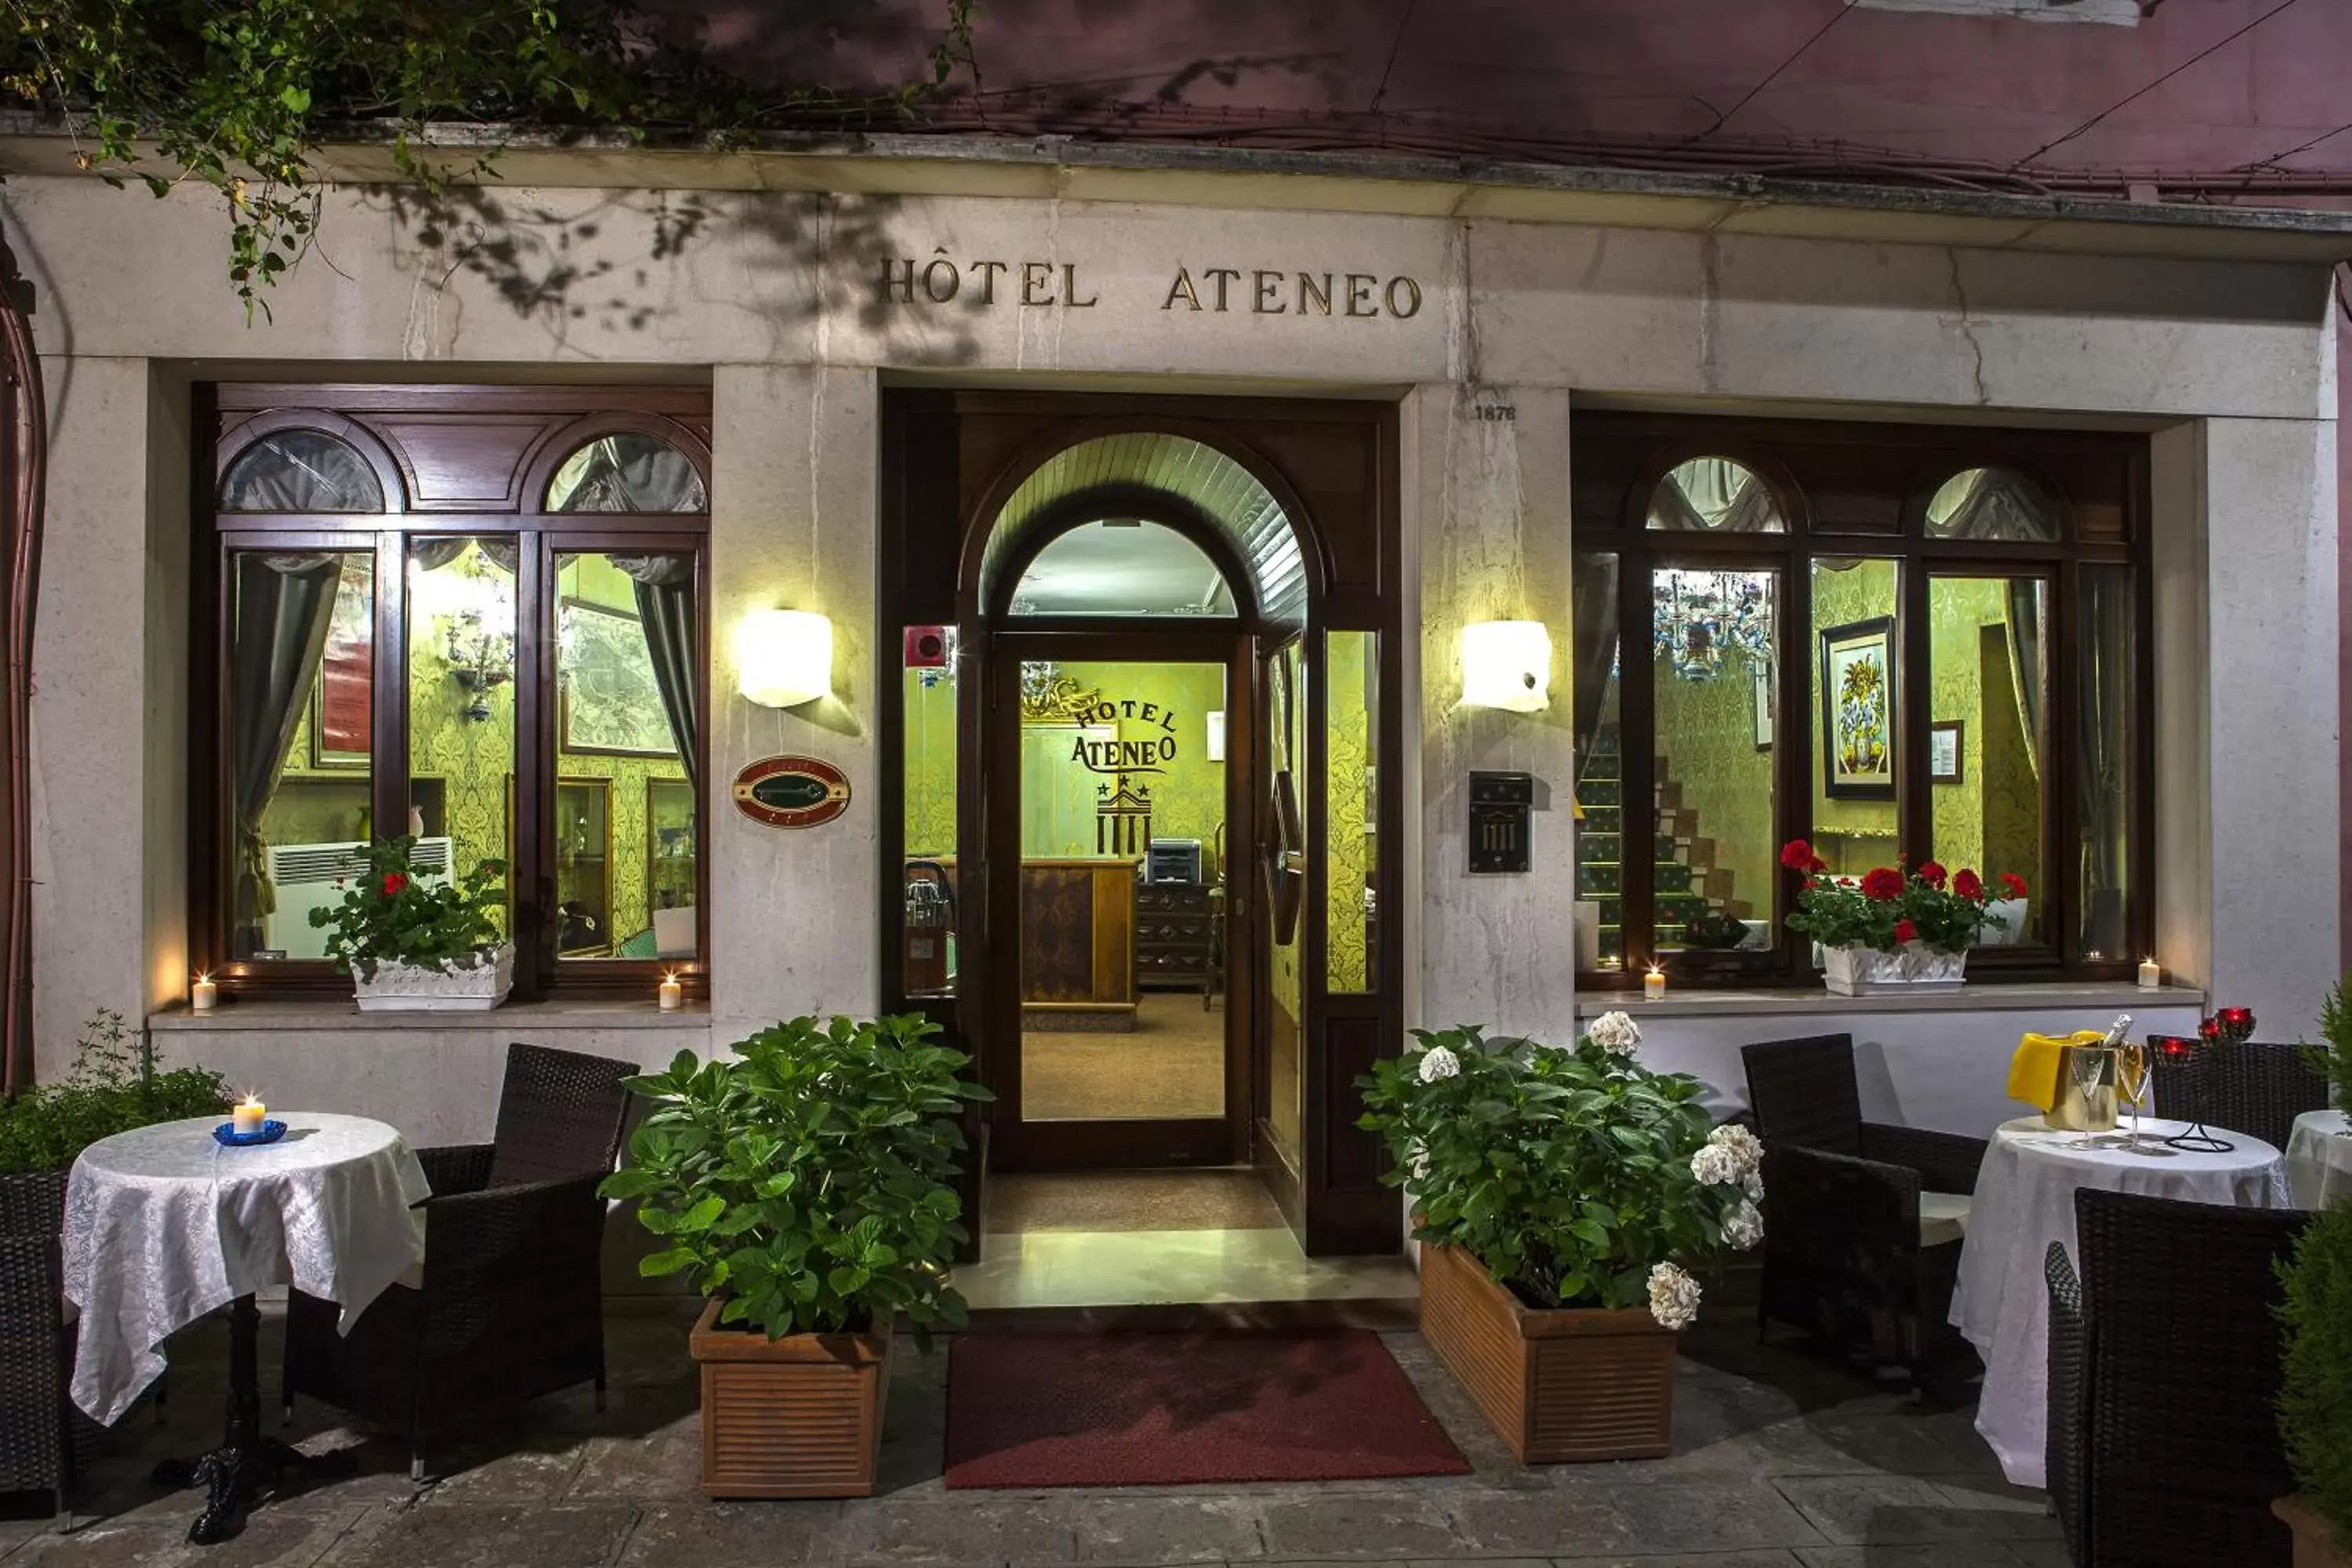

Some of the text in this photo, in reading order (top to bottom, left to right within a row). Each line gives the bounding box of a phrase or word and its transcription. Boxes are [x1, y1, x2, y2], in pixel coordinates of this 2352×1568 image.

[879, 247, 1423, 319] HÔTEL ATENEO
[1074, 700, 1177, 732] HOTEL
[1071, 736, 1177, 775] ATENEO
